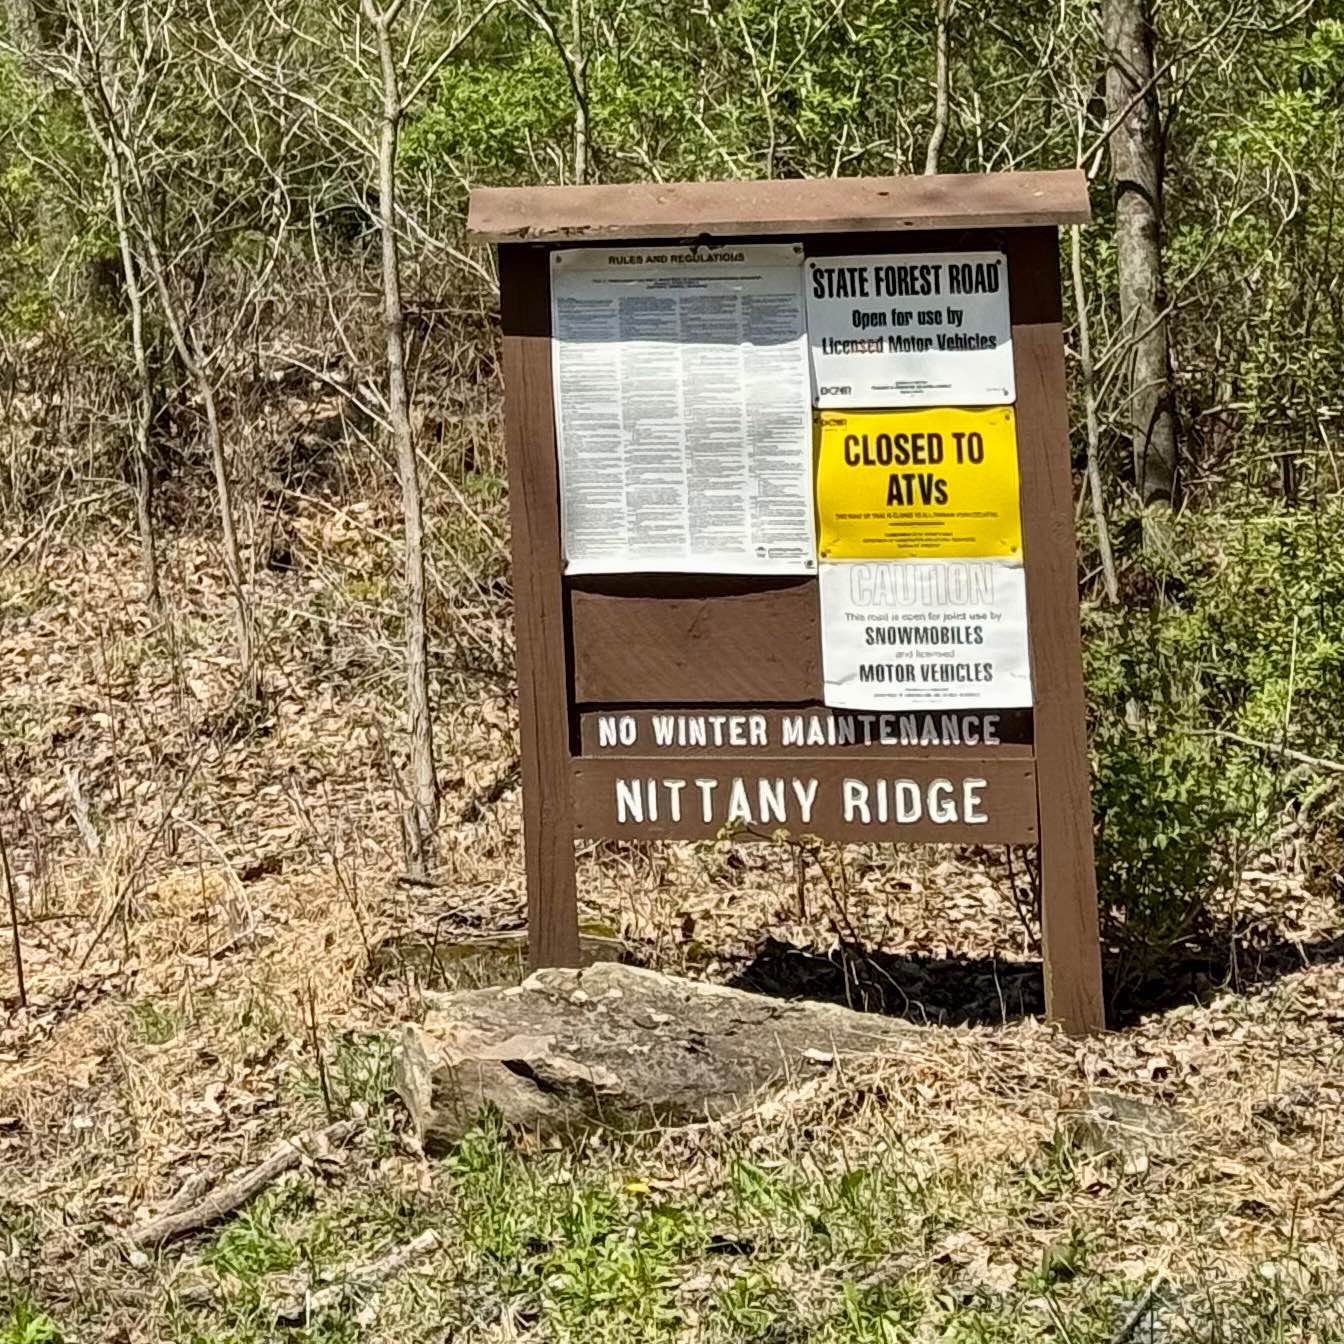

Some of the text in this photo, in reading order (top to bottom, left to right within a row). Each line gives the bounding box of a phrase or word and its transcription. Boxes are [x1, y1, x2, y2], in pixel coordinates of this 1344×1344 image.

[608, 252, 745, 265] RULES AND REGULATIONS
[813, 263, 999, 299] STATE FOREST ROAD
[852, 306, 963, 331] Open for use by
[822, 333, 997, 355] Licensed Motor Vehicles
[844, 432, 984, 467] CLOSED TO
[886, 473, 949, 506] ATVs
[850, 563, 995, 606] CAUTION
[845, 612, 865, 621] This
[891, 612, 899, 621] is
[928, 612, 940, 621] for
[943, 612, 967, 623] joint
[969, 613, 987, 621] use
[990, 611, 1002, 622] by
[865, 625, 984, 645] SNOWMOBILES
[859, 662, 993, 683] MOTOR VEHICLES
[598, 714, 1001, 746] NO WINTER MAINTENANCE
[615, 777, 989, 824] NITTANY RIDGE
